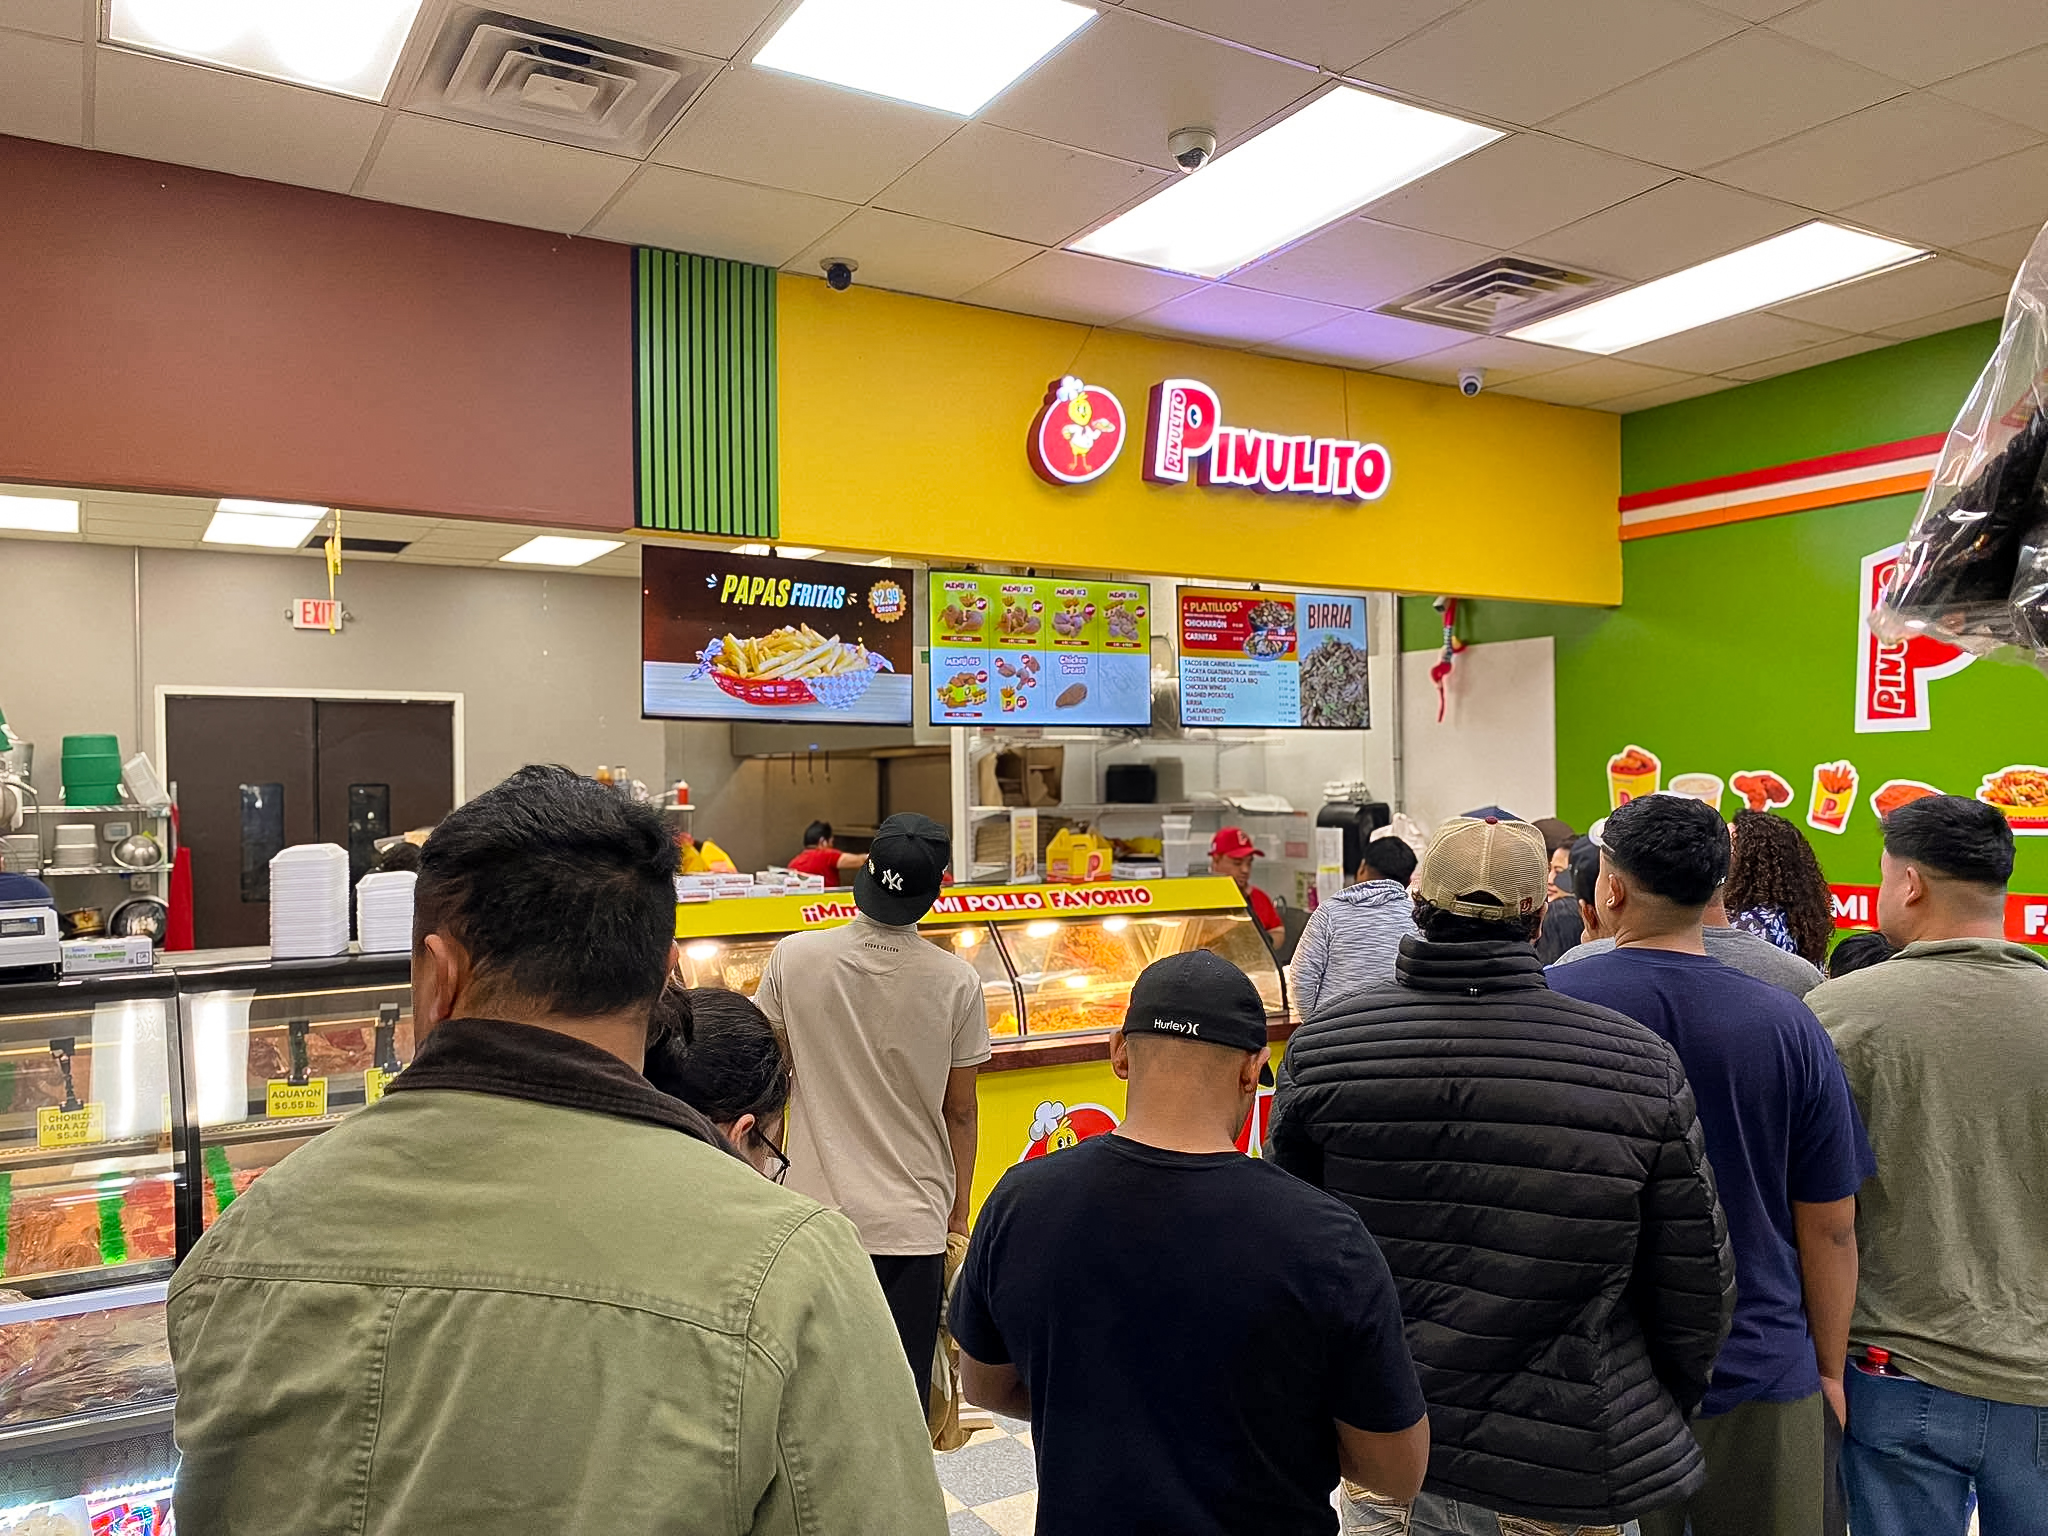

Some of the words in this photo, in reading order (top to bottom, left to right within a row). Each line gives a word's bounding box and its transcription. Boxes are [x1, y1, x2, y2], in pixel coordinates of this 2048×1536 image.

[1166, 389, 1187, 473] PINULITO
[1155, 379, 1391, 500] PINULITO
[720, 574, 791, 608] PAPAS
[790, 583, 846, 609] FRITAS
[872, 587, 900, 606] $2.99
[876, 605, 898, 613] ORDEN
[1190, 602, 1238, 612] PLATILLOS
[303, 602, 335, 624] EXIT
[1308, 604, 1352, 629] BIRRIA
[1185, 632, 1217, 641] CARNITAS
[1059, 655, 1088, 664] Chicken
[1062, 666, 1085, 674] Breast
[933, 895, 963, 913] MI
[966, 892, 1043, 911] POLLO
[1049, 887, 1152, 908] FAVORITO
[1831, 893, 1869, 921] MI
[2024, 904, 2048, 936] F
[1154, 1018, 1187, 1033] Hurley
[271, 1088, 321, 1099] AGUAYON
[274, 1101, 304, 1110] $6.55
[306, 1100, 318, 1109] lb.
[48, 1112, 94, 1123] CHORIZO
[43, 1123, 70, 1132] PARA
[56, 1131, 87, 1140] $5.49
